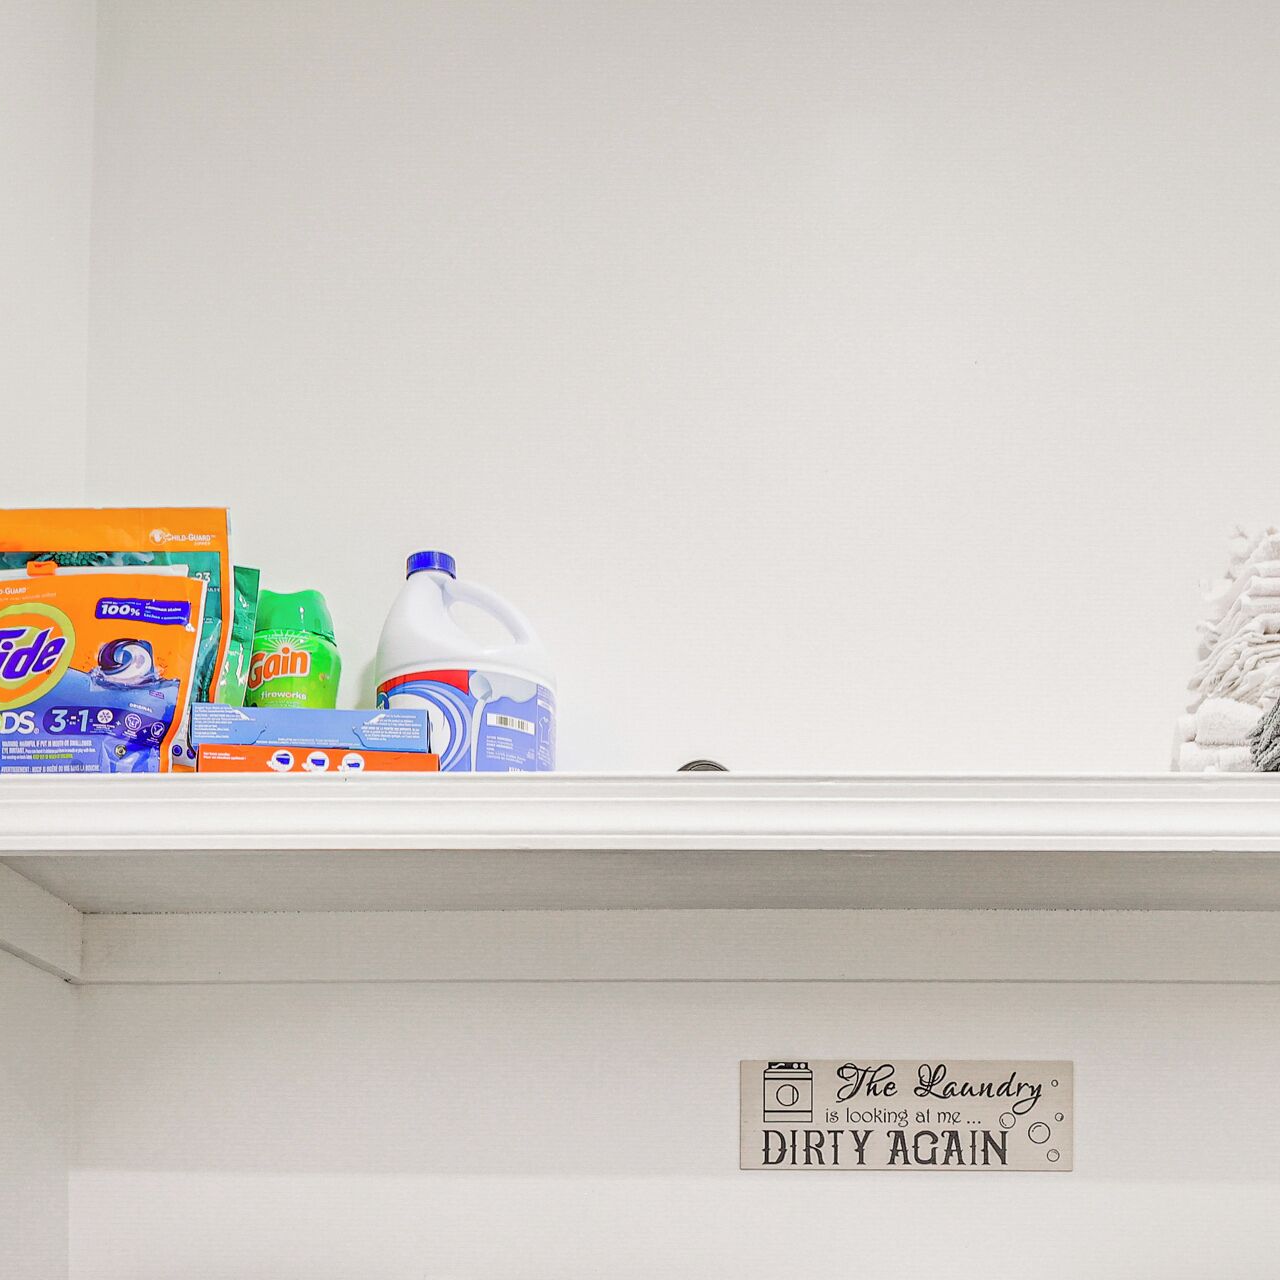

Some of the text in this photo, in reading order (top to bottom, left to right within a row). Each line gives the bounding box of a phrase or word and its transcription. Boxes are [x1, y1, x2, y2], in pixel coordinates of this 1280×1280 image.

[101, 604, 140, 617] 100%
[248, 645, 311, 691] Gain
[261, 690, 307, 700] fireworks
[836, 1062, 1043, 1115] The Laundry
[825, 1108, 839, 1123] is
[846, 1107, 909, 1127] looking
[915, 1108, 930, 1124] at
[761, 1129, 1009, 1166] DIRTY AGAIN
